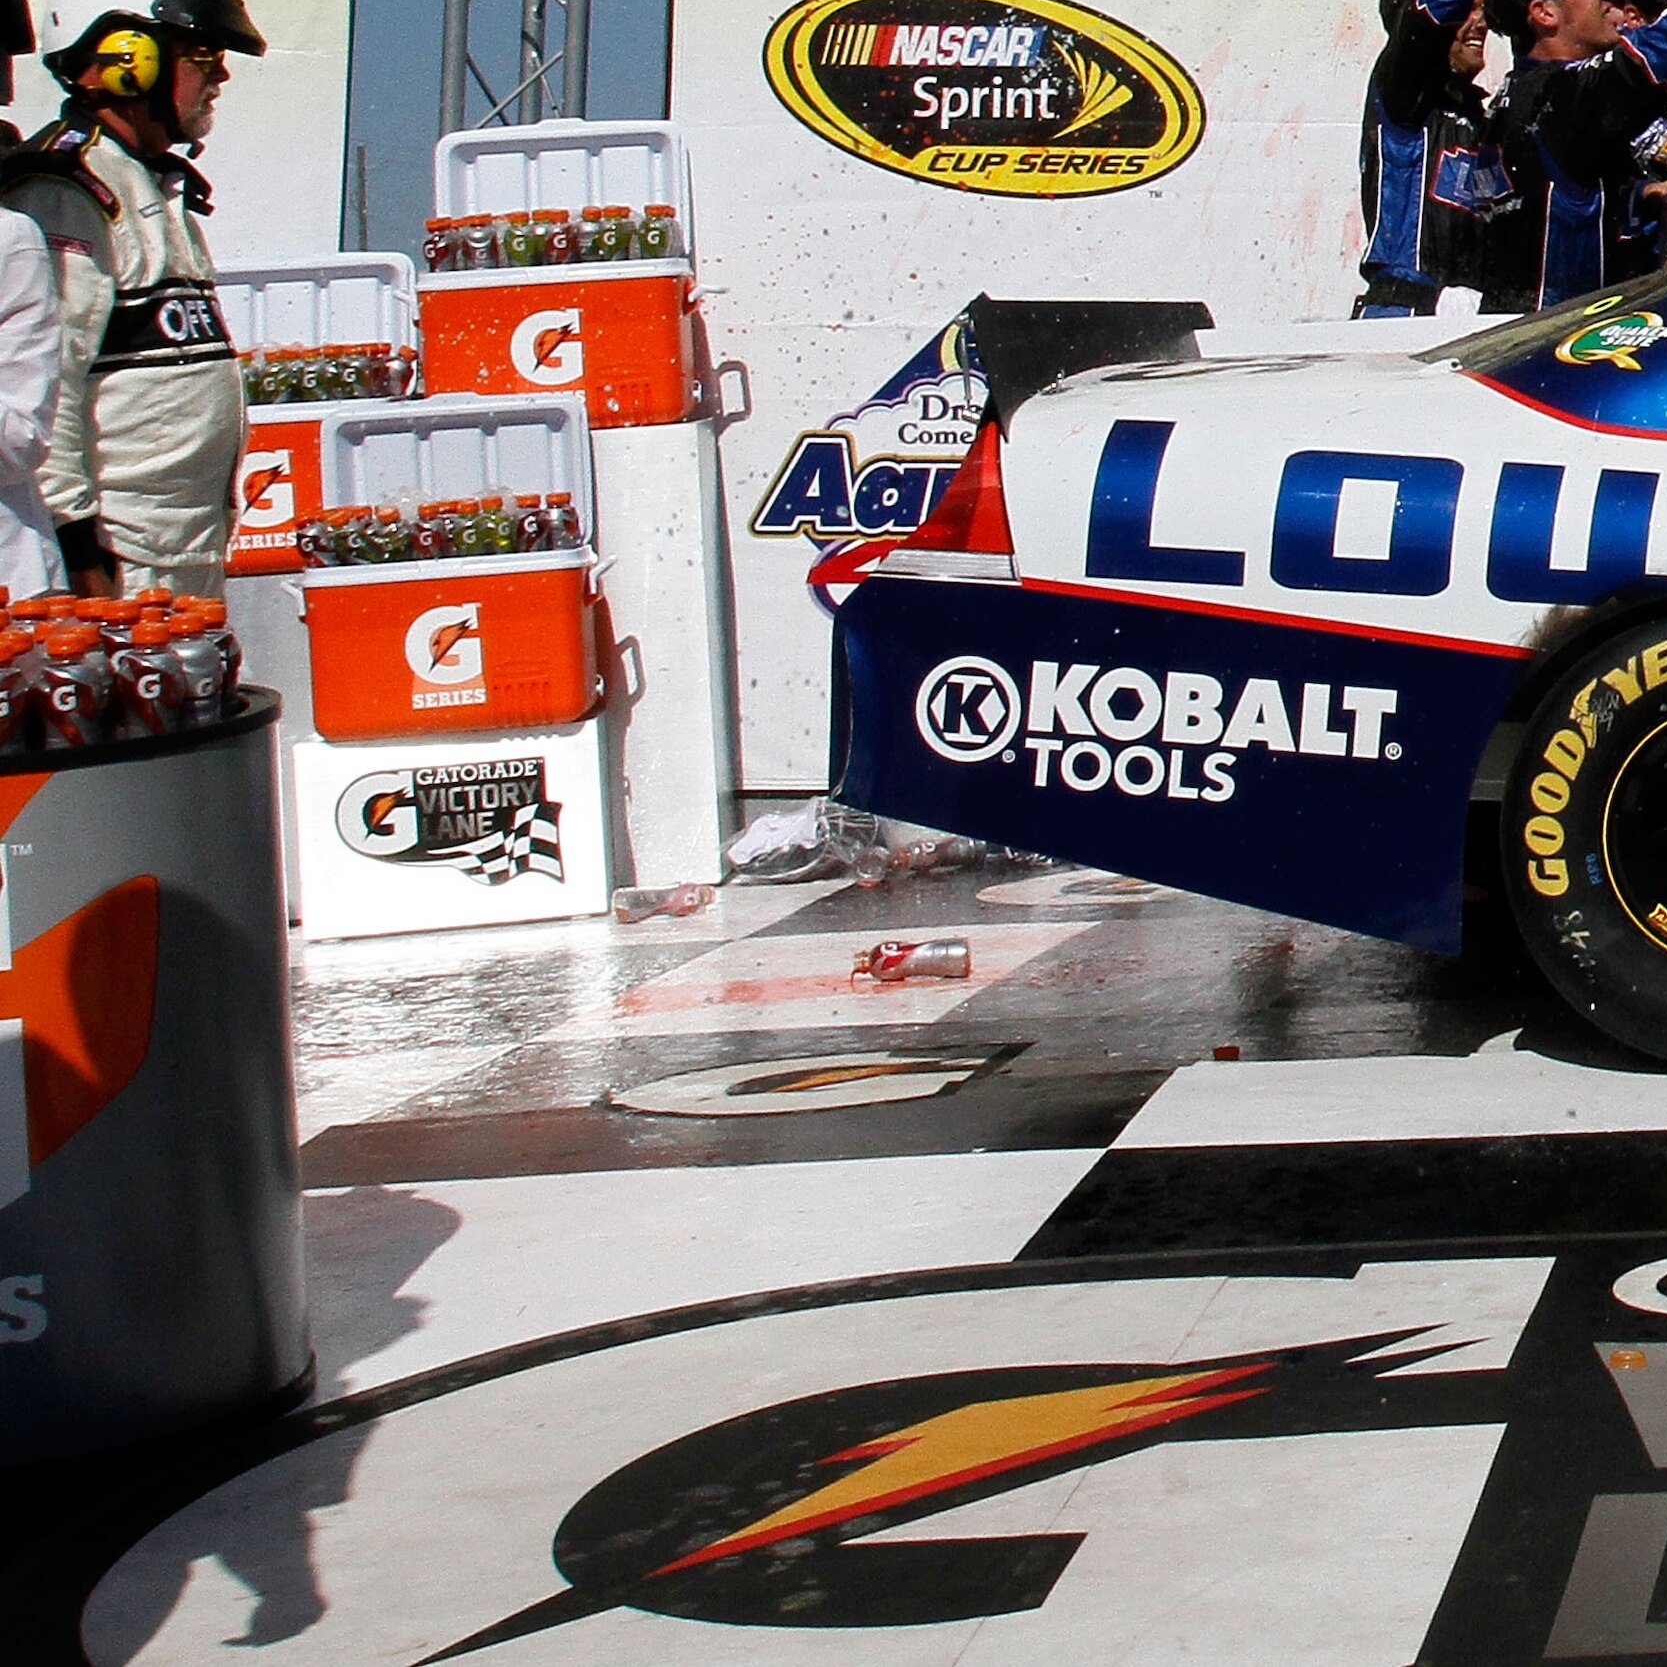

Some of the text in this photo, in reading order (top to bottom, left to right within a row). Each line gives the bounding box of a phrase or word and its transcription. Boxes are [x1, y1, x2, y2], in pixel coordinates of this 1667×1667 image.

[890, 25, 1034, 67] NASCAR
[914, 76, 1057, 128] Sprint
[929, 153, 1149, 174] CUP SERIES
[554, 233, 567, 249] G
[510, 309, 582, 386] G
[1601, 335, 1655, 347] STATE
[899, 424, 973, 444] Come
[524, 516, 537, 533] G
[231, 532, 297, 551] ERIES
[405, 603, 483, 685] G
[53, 686, 77, 711] G
[138, 672, 161, 699] G
[412, 689, 487, 710] SERIES
[1026, 660, 1398, 759] KOBALT
[416, 761, 538, 784] GATORADE
[1025, 738, 1236, 802] TOOLS
[417, 781, 537, 815] VICTORY
[337, 771, 417, 856] G
[422, 812, 494, 841] LANE
